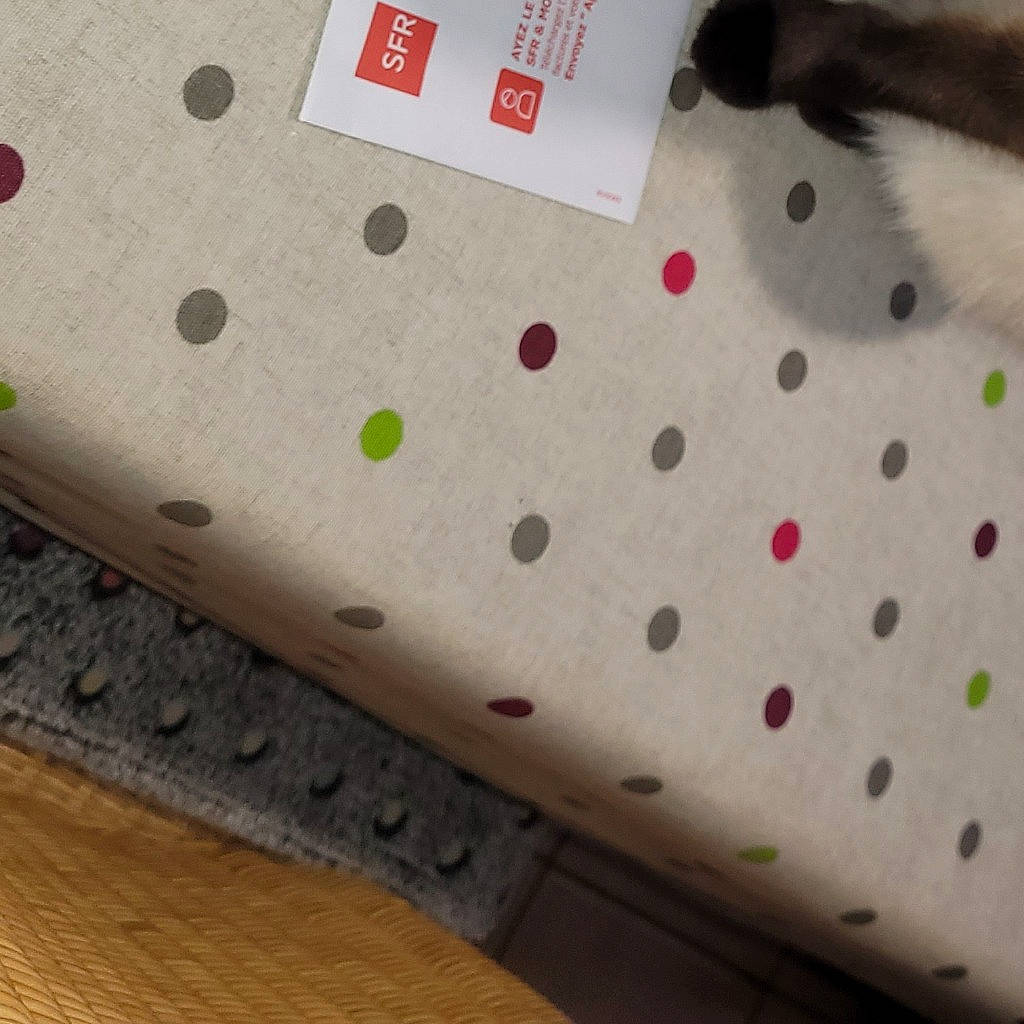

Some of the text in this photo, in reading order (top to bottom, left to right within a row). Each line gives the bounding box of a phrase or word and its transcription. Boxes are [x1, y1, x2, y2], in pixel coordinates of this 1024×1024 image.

[381, 13, 417, 73] SFR
[510, 24, 527, 60] AYEZ
[522, 1, 535, 20] LE
[526, 40, 540, 65] SFR
[534, 23, 545, 35] &
[565, 24, 588, 81] Envoyez
